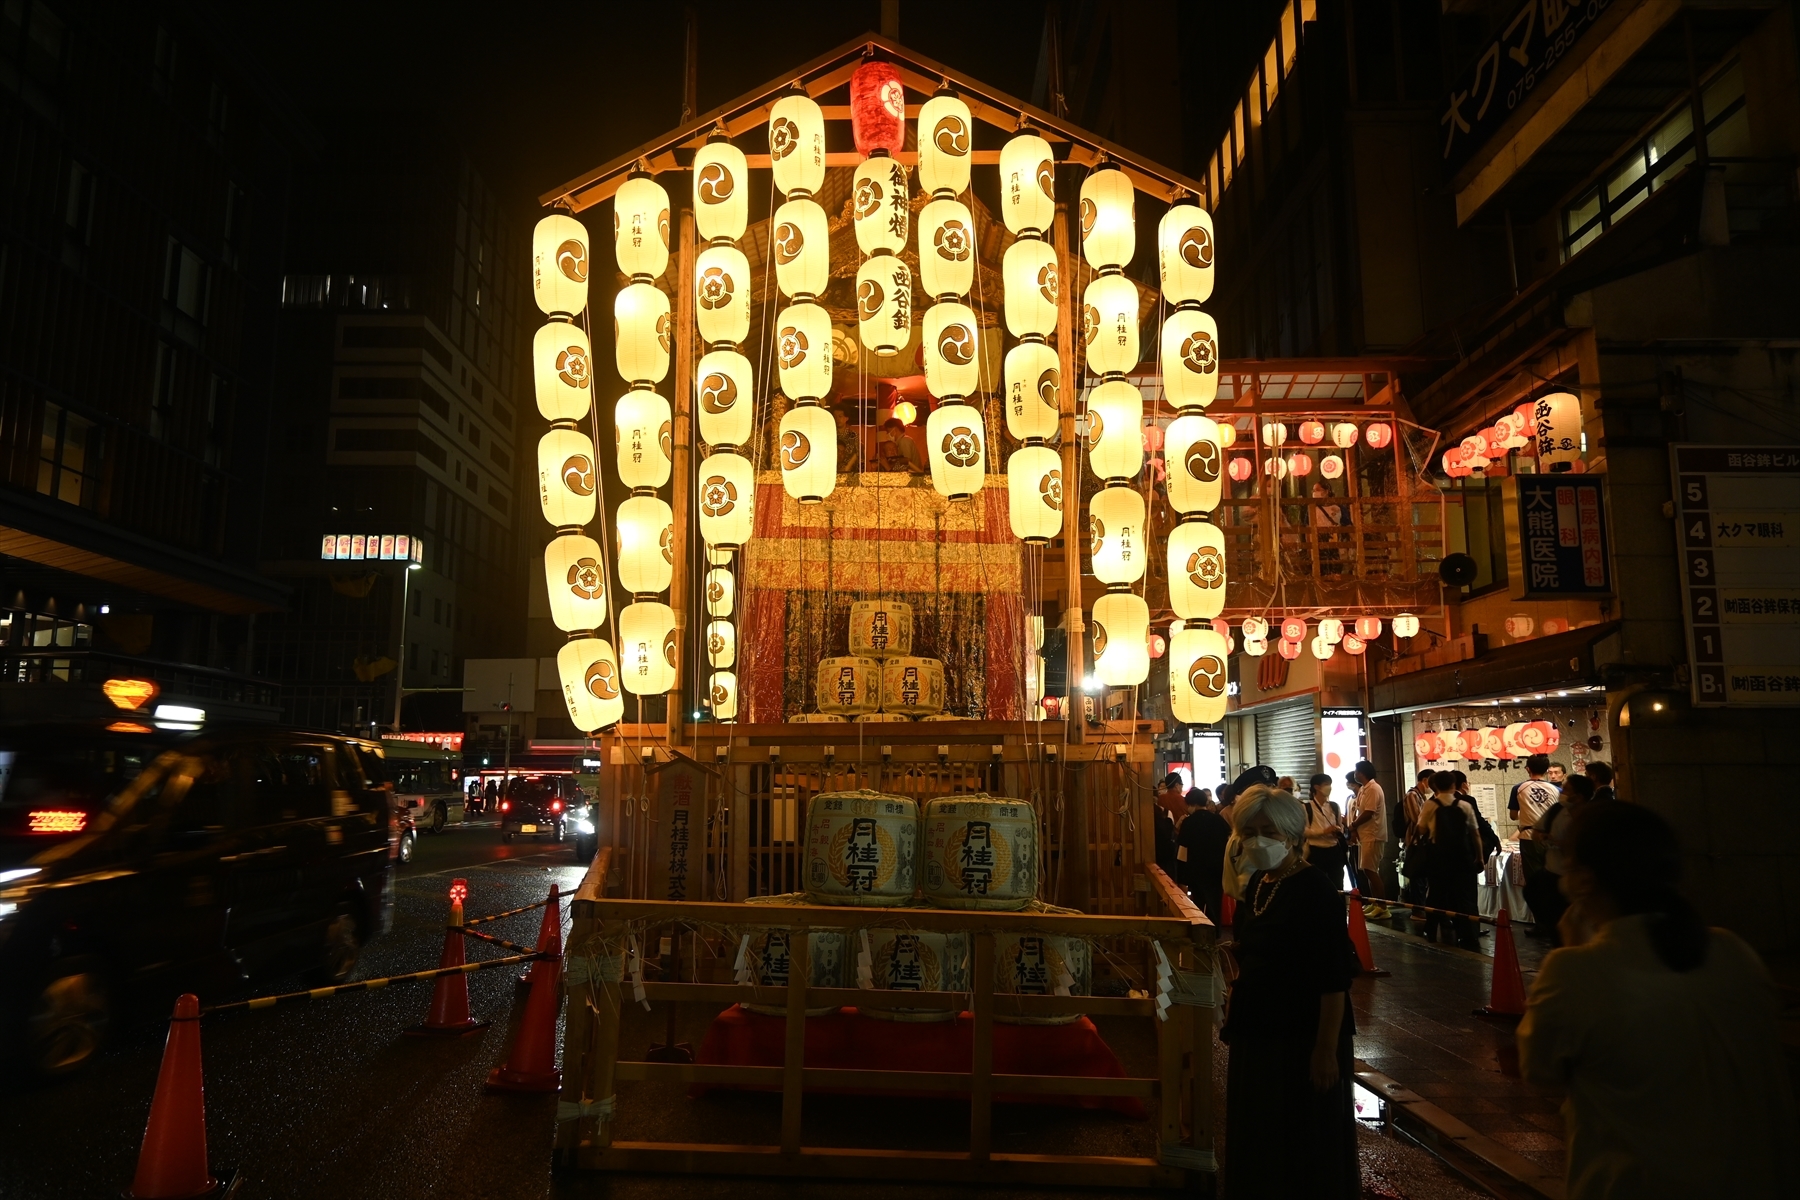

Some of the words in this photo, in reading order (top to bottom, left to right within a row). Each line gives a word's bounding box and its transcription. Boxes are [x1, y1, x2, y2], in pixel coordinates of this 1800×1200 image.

[1011, 171, 1020, 205] 月桂冠
[632, 214, 642, 247] 月桂冠
[1117, 312, 1127, 347] 月桂冠
[1012, 382, 1022, 416] 月桂冠
[1535, 399, 1557, 457] 函谷鉾
[632, 429, 642, 463] 月桂冠
[1728, 453, 1800, 468] 函谷鉾ビル
[1687, 482, 1703, 502] 5
[1557, 489, 1578, 545] 眼科
[1689, 520, 1706, 540] 4
[1717, 522, 1784, 538] 大クマ眼科
[1121, 527, 1132, 561] 月桂冠
[1525, 484, 1560, 588] 大熊医院
[1578, 488, 1603, 584] 糖尿病内科
[1693, 557, 1709, 578] 3
[1696, 596, 1713, 616] 2
[871, 612, 888, 650] 月桂冠
[1702, 634, 1714, 655] 1
[638, 642, 648, 676] 月桂冠
[838, 667, 856, 706] 月桂冠
[902, 667, 920, 706] 月桂冠
[673, 774, 692, 806] 献酒
[846, 818, 879, 892] 月桂冠
[960, 821, 994, 894] 月桂冠
